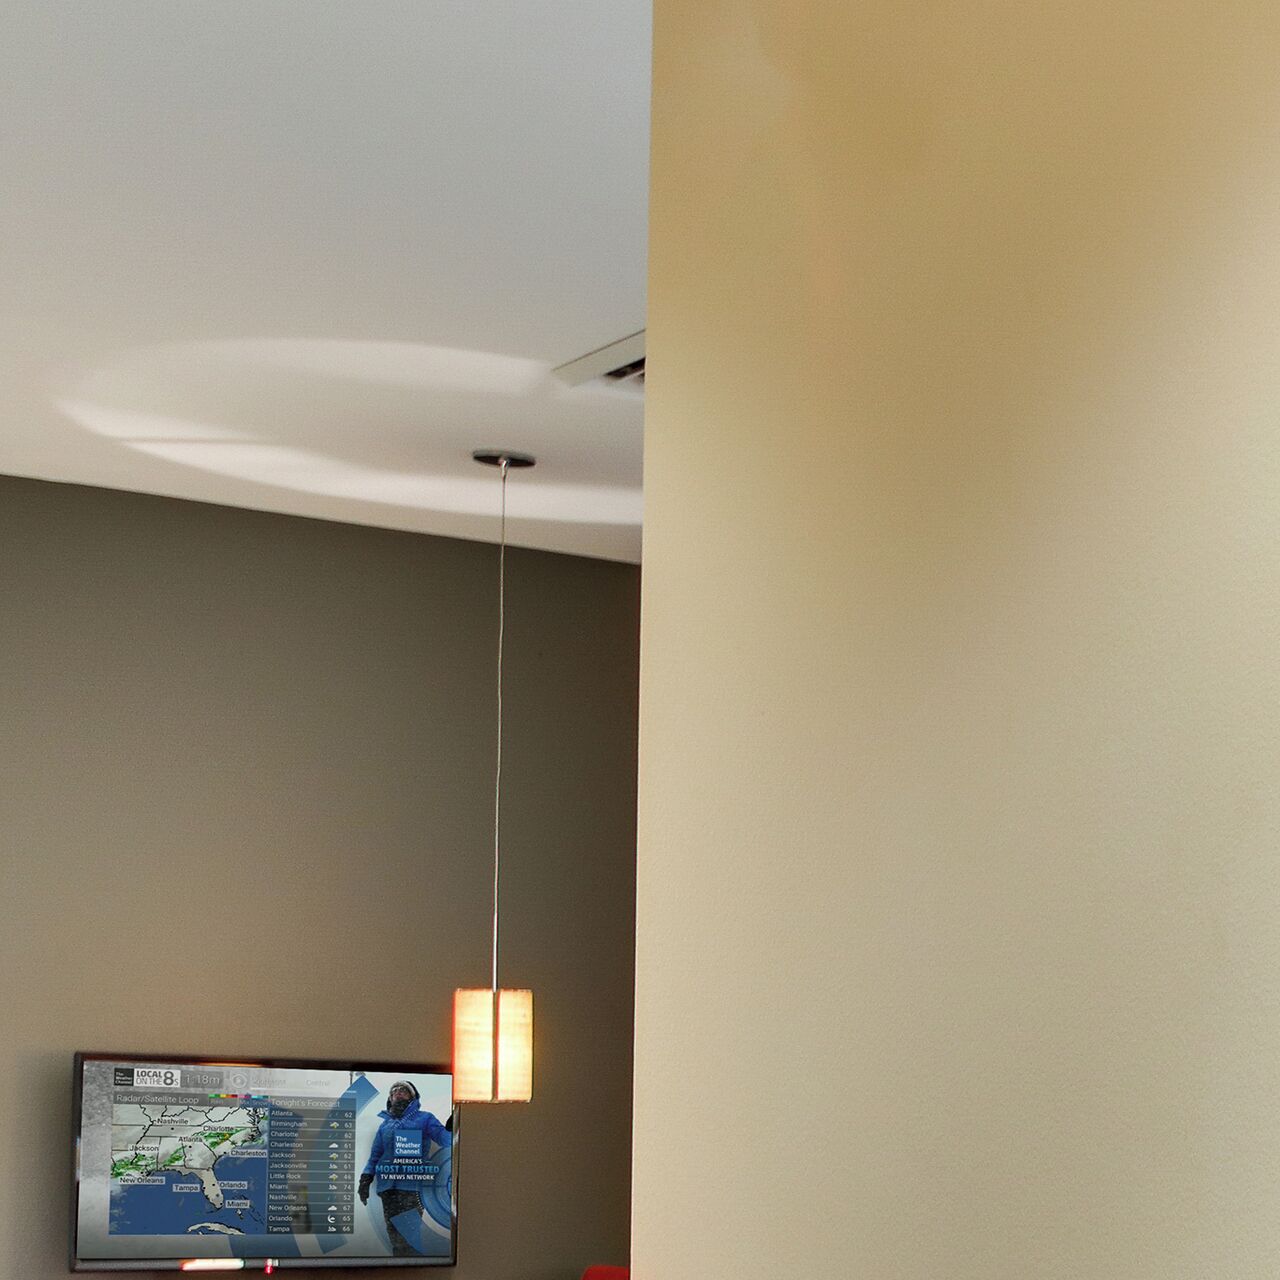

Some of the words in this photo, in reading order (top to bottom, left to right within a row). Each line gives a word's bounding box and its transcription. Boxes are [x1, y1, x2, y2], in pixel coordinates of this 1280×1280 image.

[136, 1070, 162, 1078] LOCAL
[136, 1077, 149, 1085] ON
[116, 1094, 177, 1104] Radar/Satellite
[178, 1095, 200, 1105] Loop
[272, 1099, 307, 1108] Tonight's
[307, 1100, 341, 1108] Forecast
[129, 1144, 159, 1152] Jackson
[376, 1165, 399, 1173] MOST
[403, 1165, 440, 1173] TRUSTED
[119, 1176, 137, 1184] New
[174, 1184, 199, 1192] Tampa
